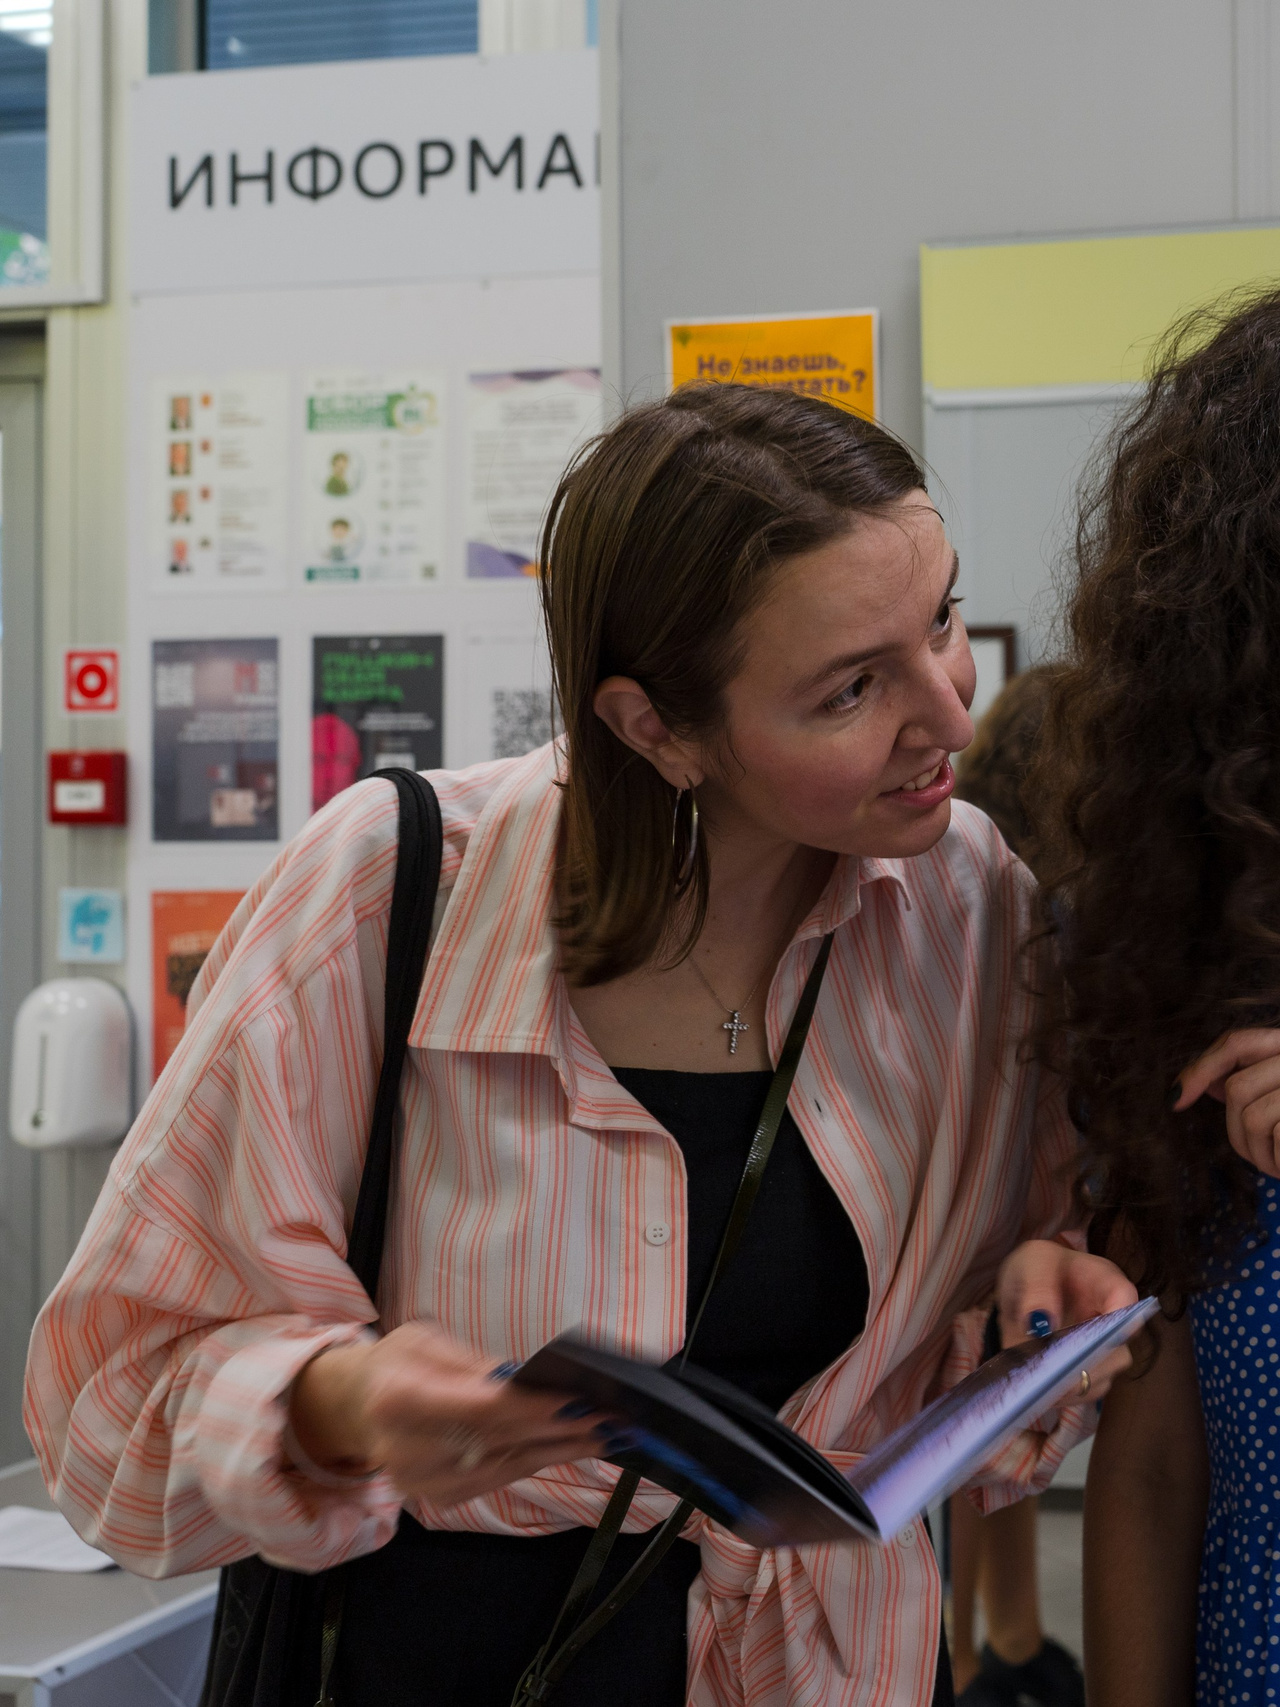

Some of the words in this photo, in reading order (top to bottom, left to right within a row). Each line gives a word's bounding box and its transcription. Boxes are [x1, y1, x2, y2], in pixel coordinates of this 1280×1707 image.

[168, 133, 600, 210] ИНФОРМА
[697, 354, 732, 377] Не
[742, 354, 847, 376] знаешь,
